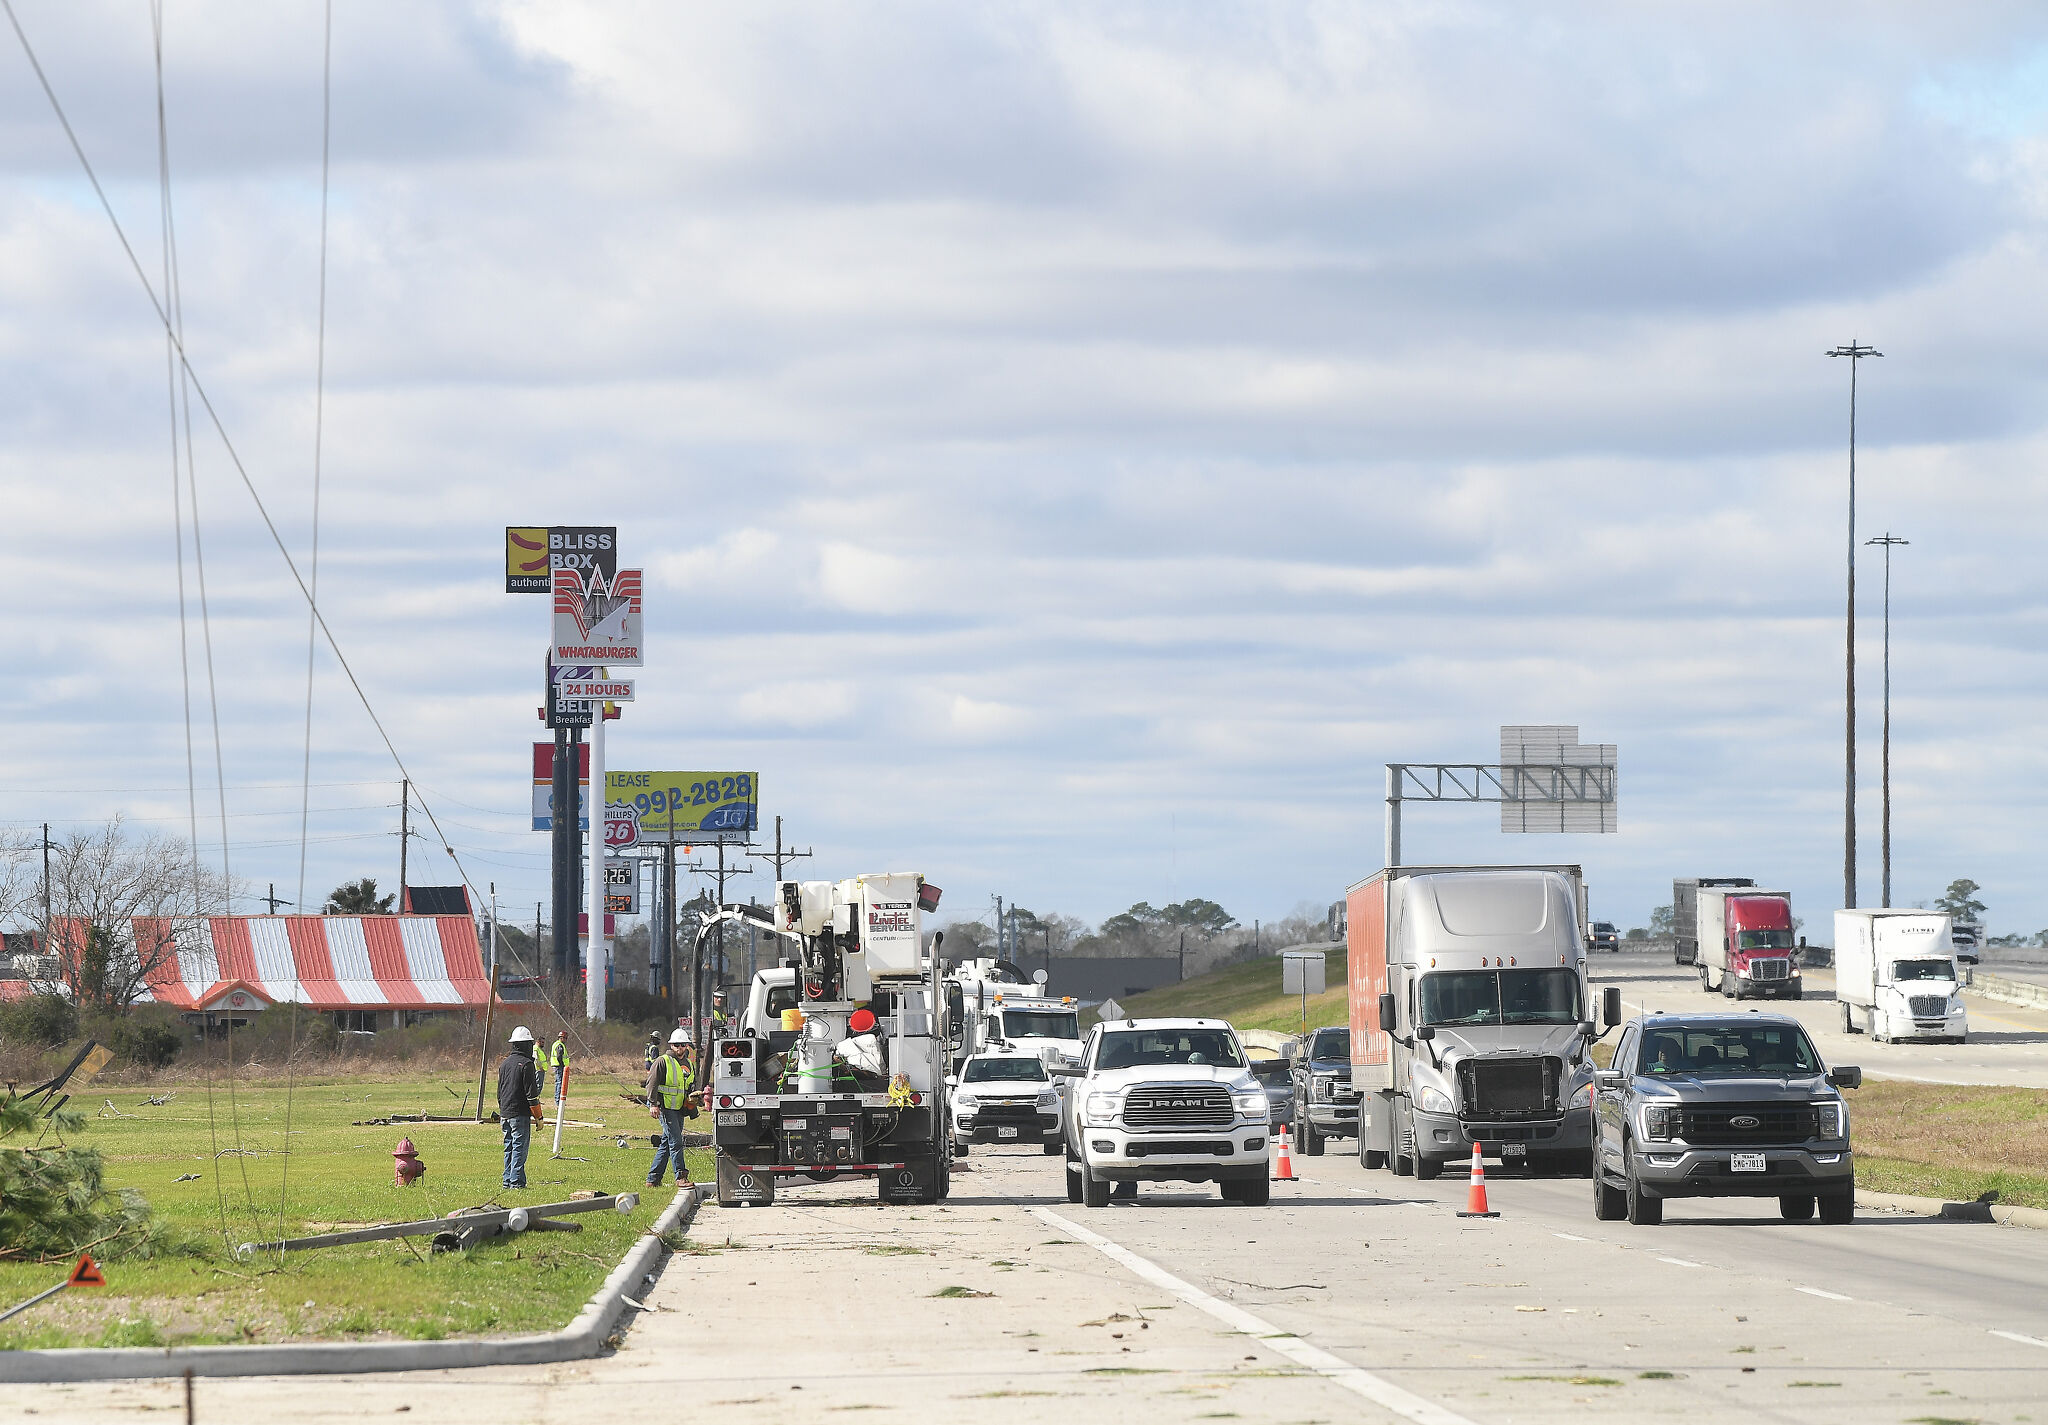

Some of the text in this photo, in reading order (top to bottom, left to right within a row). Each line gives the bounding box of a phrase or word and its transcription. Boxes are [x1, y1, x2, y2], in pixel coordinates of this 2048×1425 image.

[550, 534, 612, 550] BLISS
[550, 553, 594, 569] BOX
[510, 577, 551, 587] authenti
[558, 646, 638, 658] WHATABURGER
[566, 684, 581, 695] 24
[585, 684, 630, 696] HOURS
[555, 715, 593, 724] Breakfas
[611, 774, 650, 788] LEASE
[604, 811, 633, 819] HILLIPS
[603, 822, 629, 840] 66
